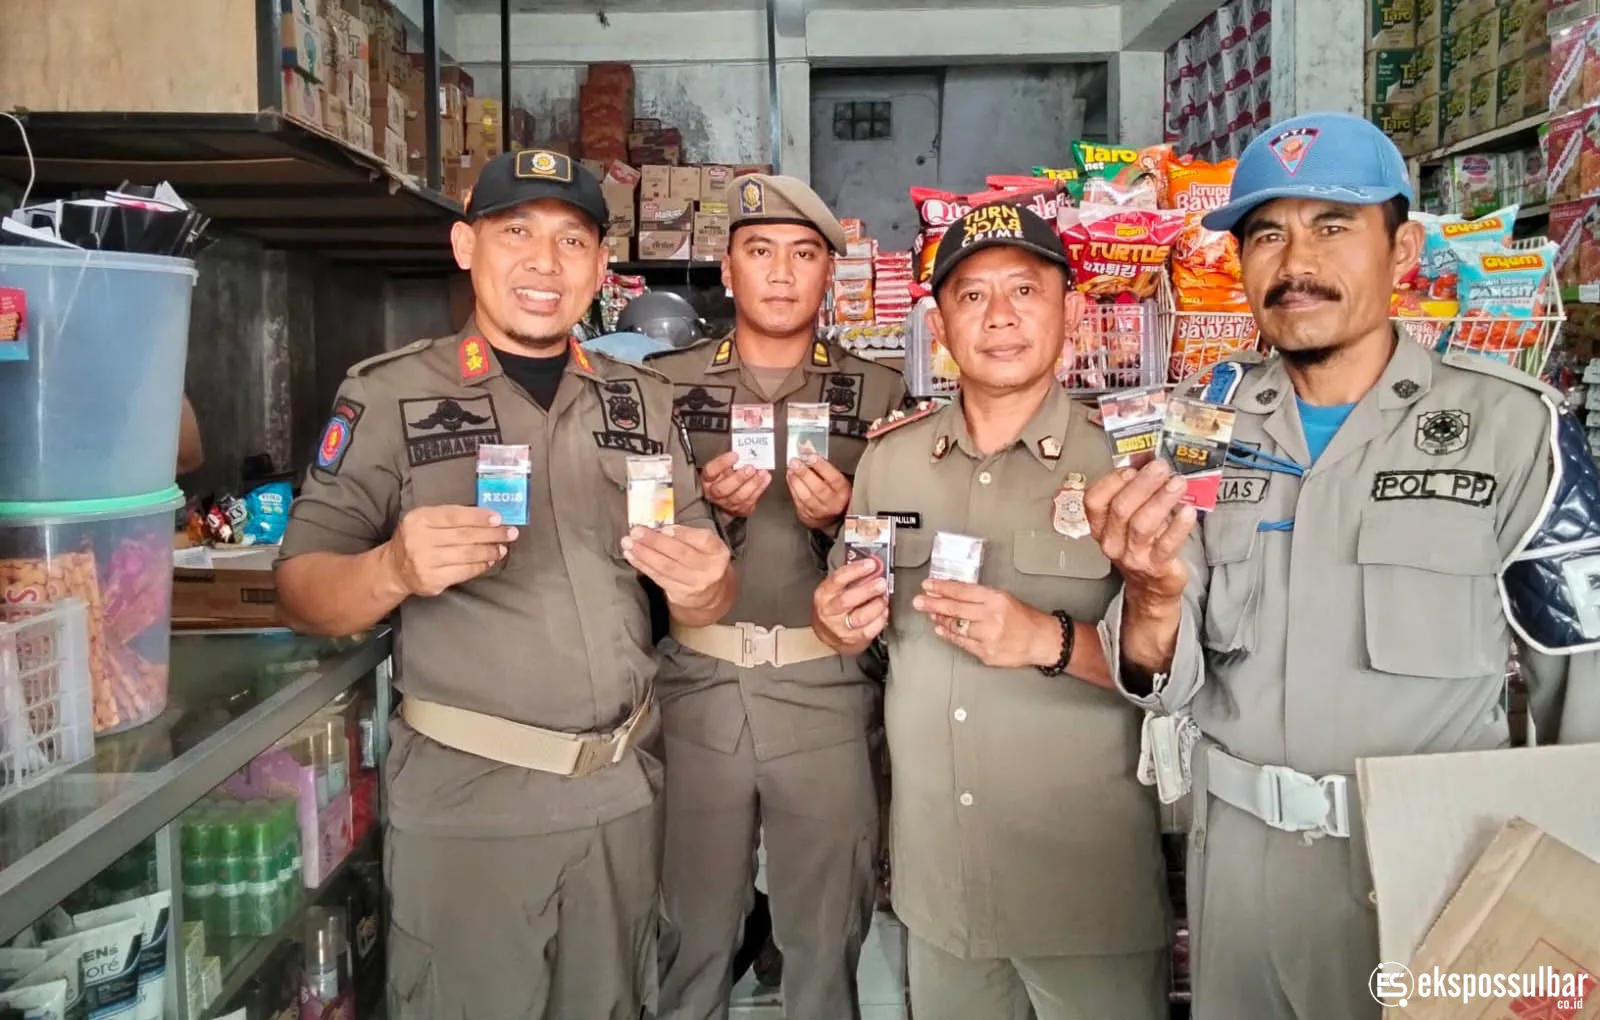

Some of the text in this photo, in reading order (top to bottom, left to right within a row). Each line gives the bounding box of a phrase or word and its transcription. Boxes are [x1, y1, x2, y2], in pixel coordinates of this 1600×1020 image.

[1081, 144, 1137, 163] Taro
[1085, 162, 1105, 170] net
[963, 205, 1018, 225] TURN
[1444, 218, 1497, 234] ayam
[962, 230, 1024, 248] CRIME
[1089, 242, 1170, 263] TURTOS
[1484, 255, 1537, 267] ayam
[738, 437, 768, 447] LOUIS
[1177, 445, 1208, 460] BSJ
[1216, 481, 1252, 499] IAS
[1380, 473, 1487, 499] POL PP
[86, 957, 120, 978] oré
